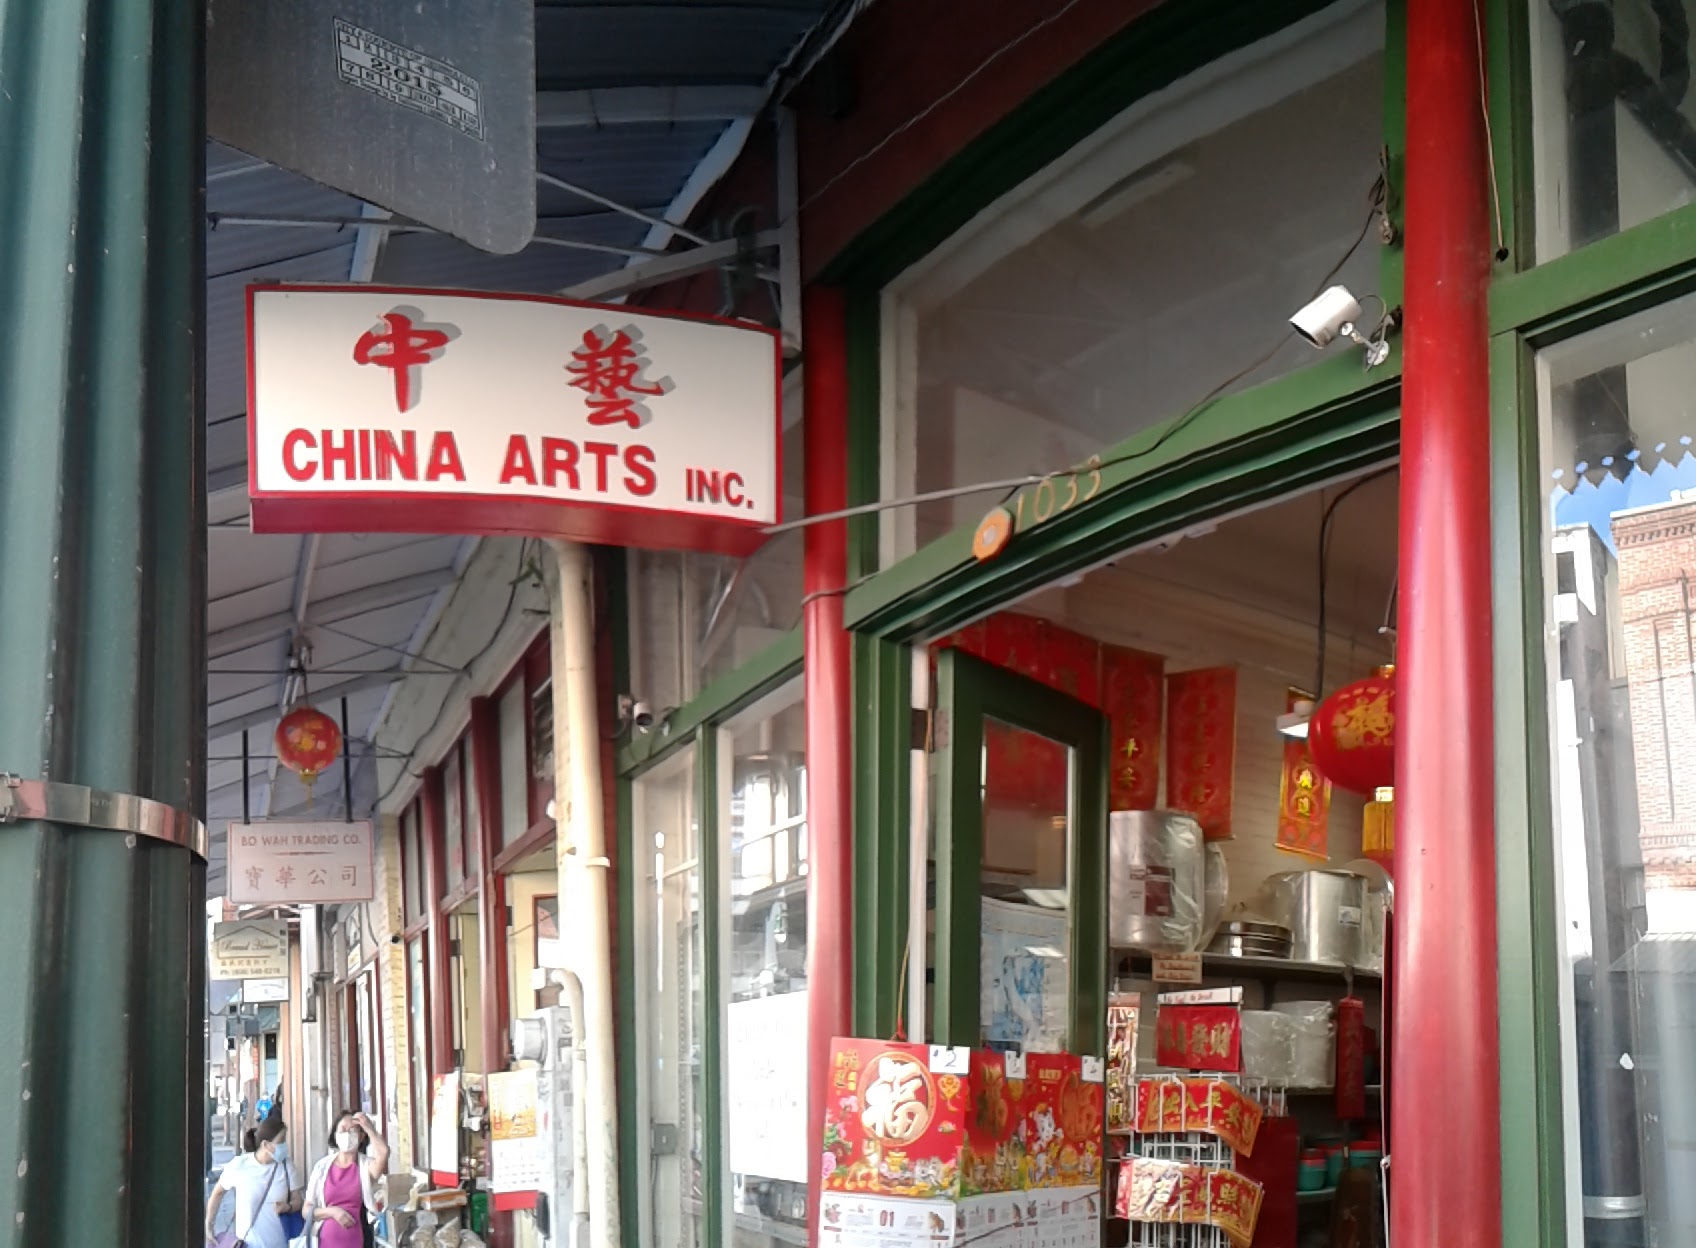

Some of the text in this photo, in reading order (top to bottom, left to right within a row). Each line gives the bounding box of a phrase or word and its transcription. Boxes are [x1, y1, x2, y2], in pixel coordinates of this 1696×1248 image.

[282, 428, 756, 510] CHINA ARTS INC.
[241, 834, 362, 847] BO WAH TRADING CO.
